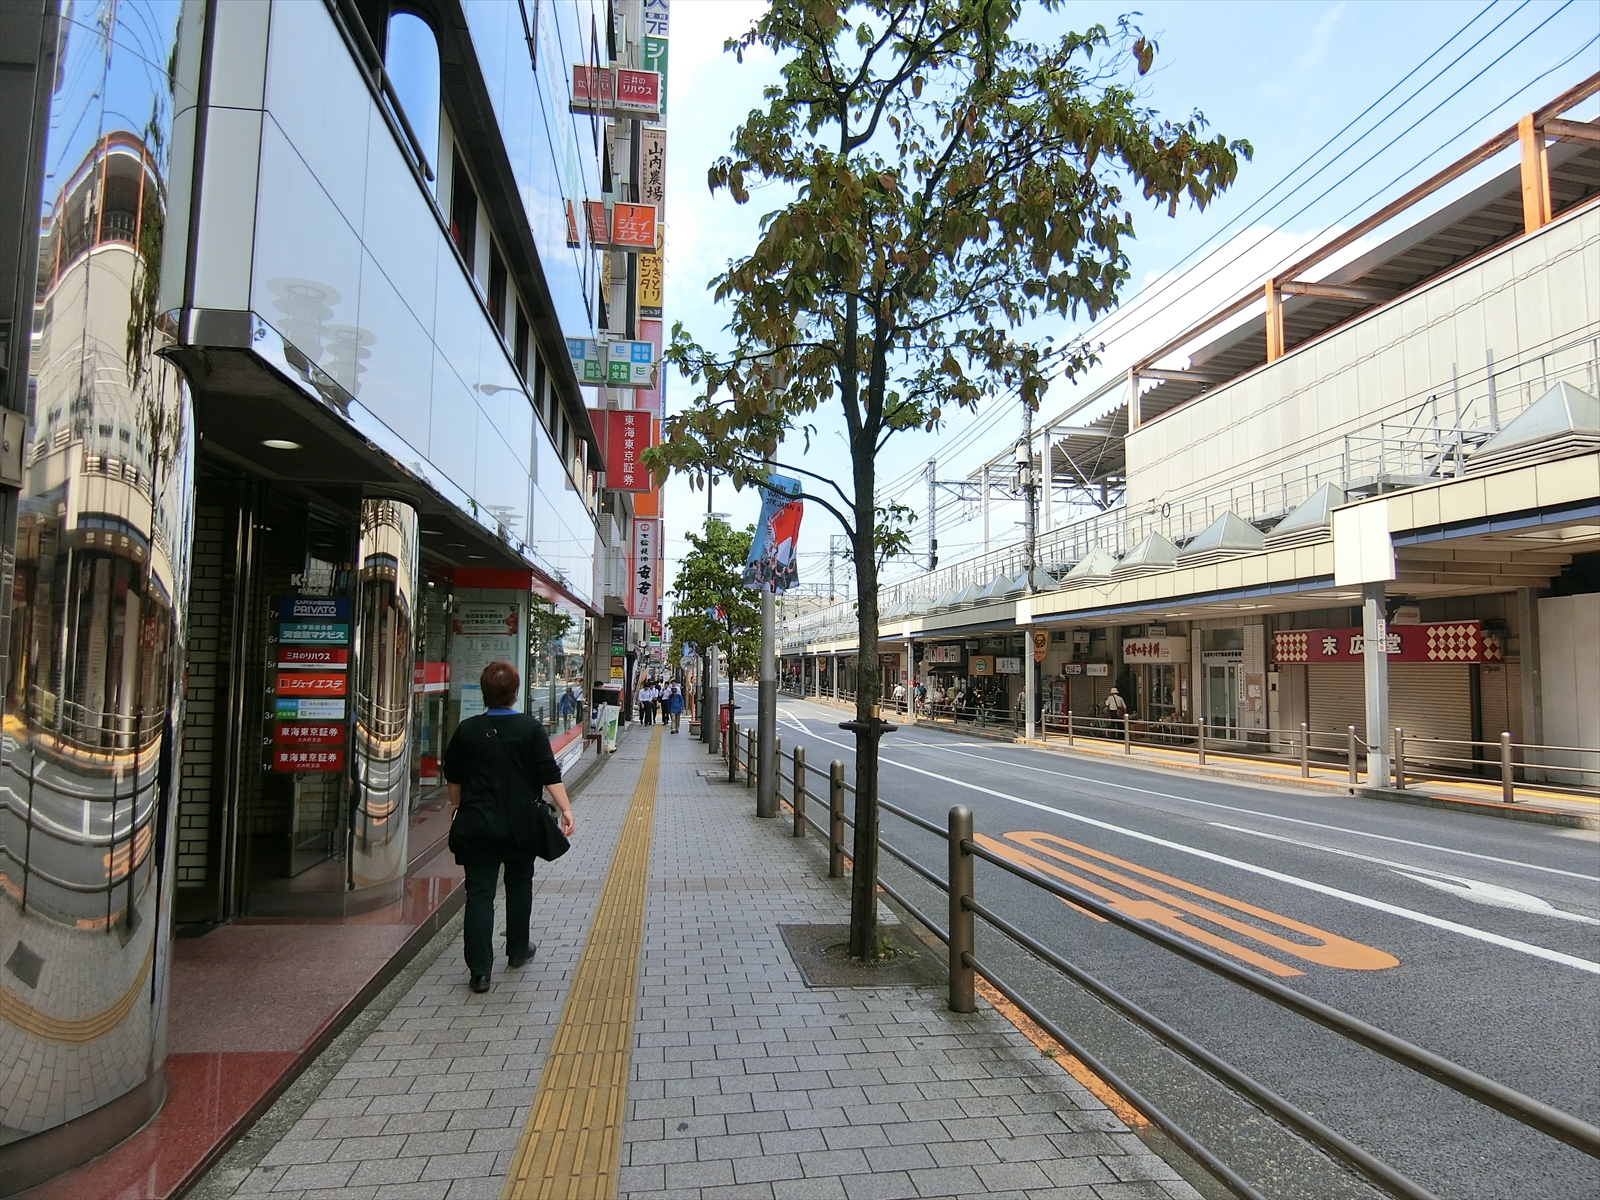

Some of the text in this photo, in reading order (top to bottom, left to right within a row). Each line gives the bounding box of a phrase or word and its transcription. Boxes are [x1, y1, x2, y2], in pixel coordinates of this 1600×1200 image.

[646, 21, 667, 35] 7F
[624, 75, 646, 84] 三井の
[623, 85, 652, 95] リハウス
[647, 141, 664, 202] 山内農場
[617, 219, 650, 230] ジェイ
[616, 230, 650, 241] エステ
[641, 257, 651, 299] センター
[652, 257, 663, 301] やきとり
[623, 415, 635, 485] 東海東京証券
[637, 564, 651, 596] 安安
[294, 606, 337, 614] PRIVATO
[283, 631, 344, 639] 河合塾マナビス
[1322, 634, 1402, 656] 末広堂
[286, 652, 331, 660] 三井のリハウス
[1067, 665, 1080, 673] たばこ
[291, 680, 343, 688] ジェイ エステ
[264, 711, 275, 719] 3F
[281, 727, 338, 737] 東海東京証券
[263, 737, 273, 745] 2F
[280, 753, 337, 762] 東海東京証券
